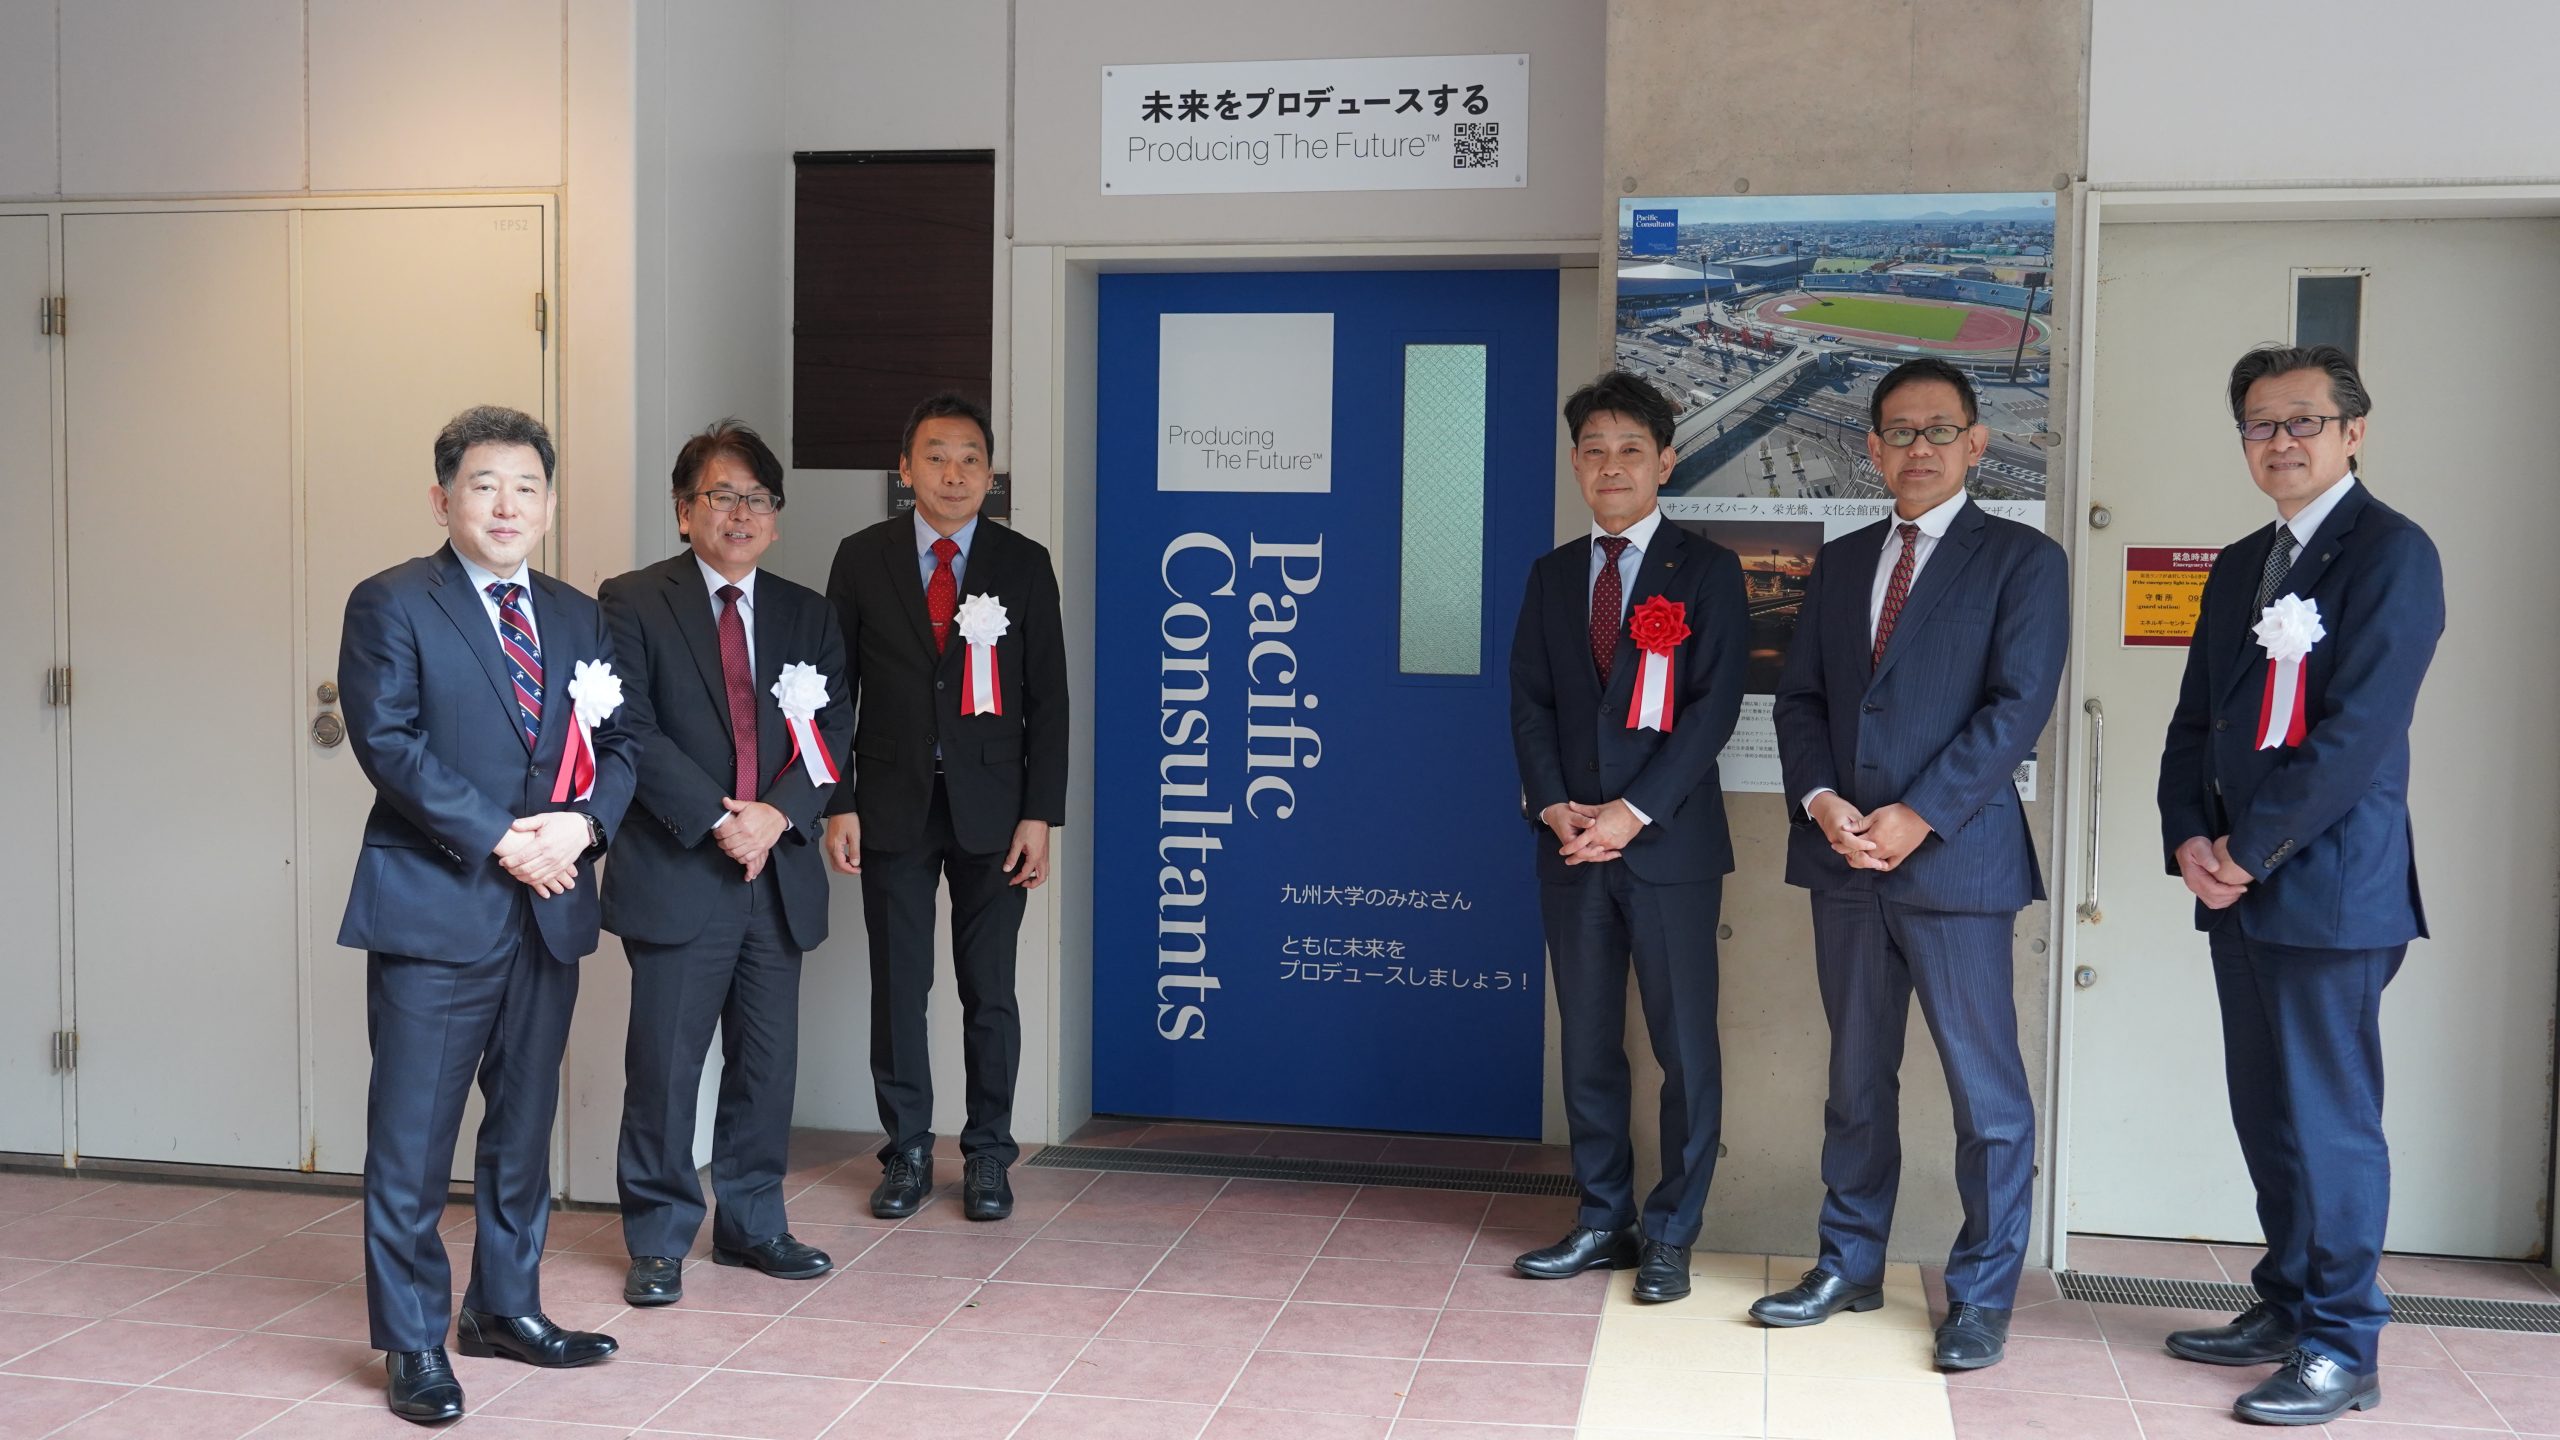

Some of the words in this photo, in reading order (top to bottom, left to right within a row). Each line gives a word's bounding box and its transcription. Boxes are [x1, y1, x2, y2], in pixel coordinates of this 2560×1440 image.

[1142, 84, 1489, 124] 未来をプロデュースする
[1128, 135, 1270, 166] Producing
[1273, 133, 1329, 160] The
[1169, 425, 1275, 450] Producing
[1201, 449, 1242, 470] The
[1246, 532, 1323, 819] Pacific
[1157, 532, 1236, 1041] Consultants
[1281, 884, 1472, 911] 九州大学のみなさん
[1282, 936, 1406, 959] ともに未来を
[1280, 960, 1528, 991] プロデュースしましょう！
